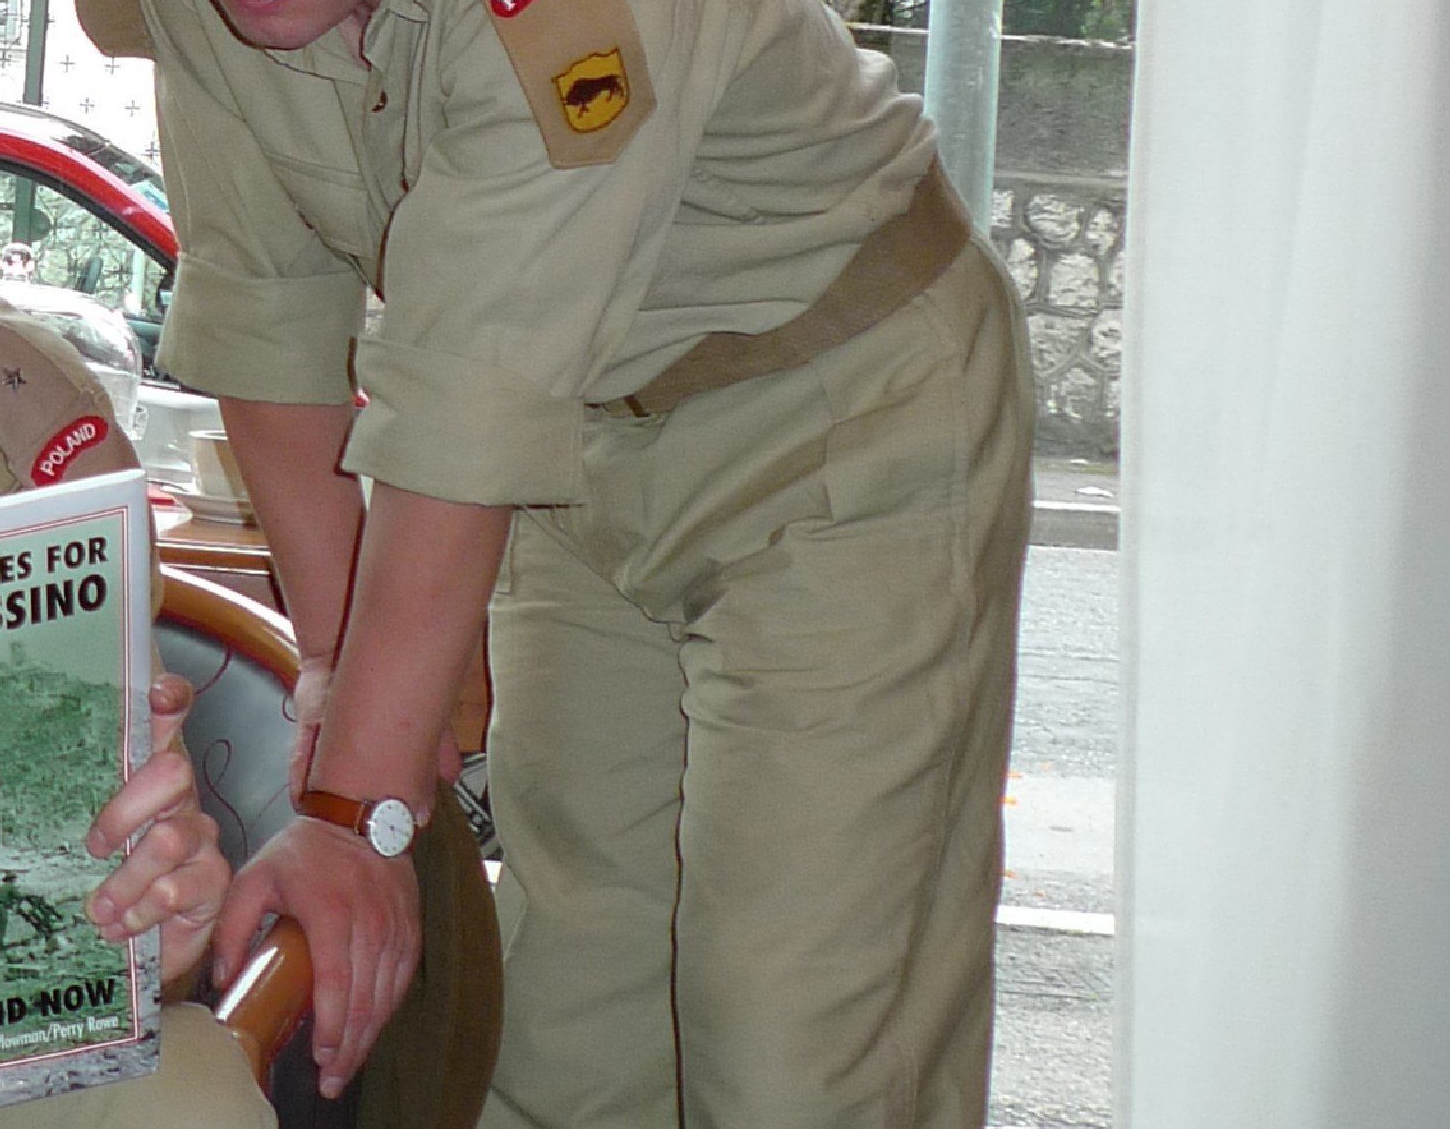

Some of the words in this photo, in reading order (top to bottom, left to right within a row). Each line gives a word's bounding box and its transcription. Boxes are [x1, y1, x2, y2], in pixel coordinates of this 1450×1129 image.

[39, 423, 96, 477] POLAND
[46, 536, 108, 573] FOR
[40, 979, 115, 1016] NOW
[86, 1016, 119, 1032] Rowe
